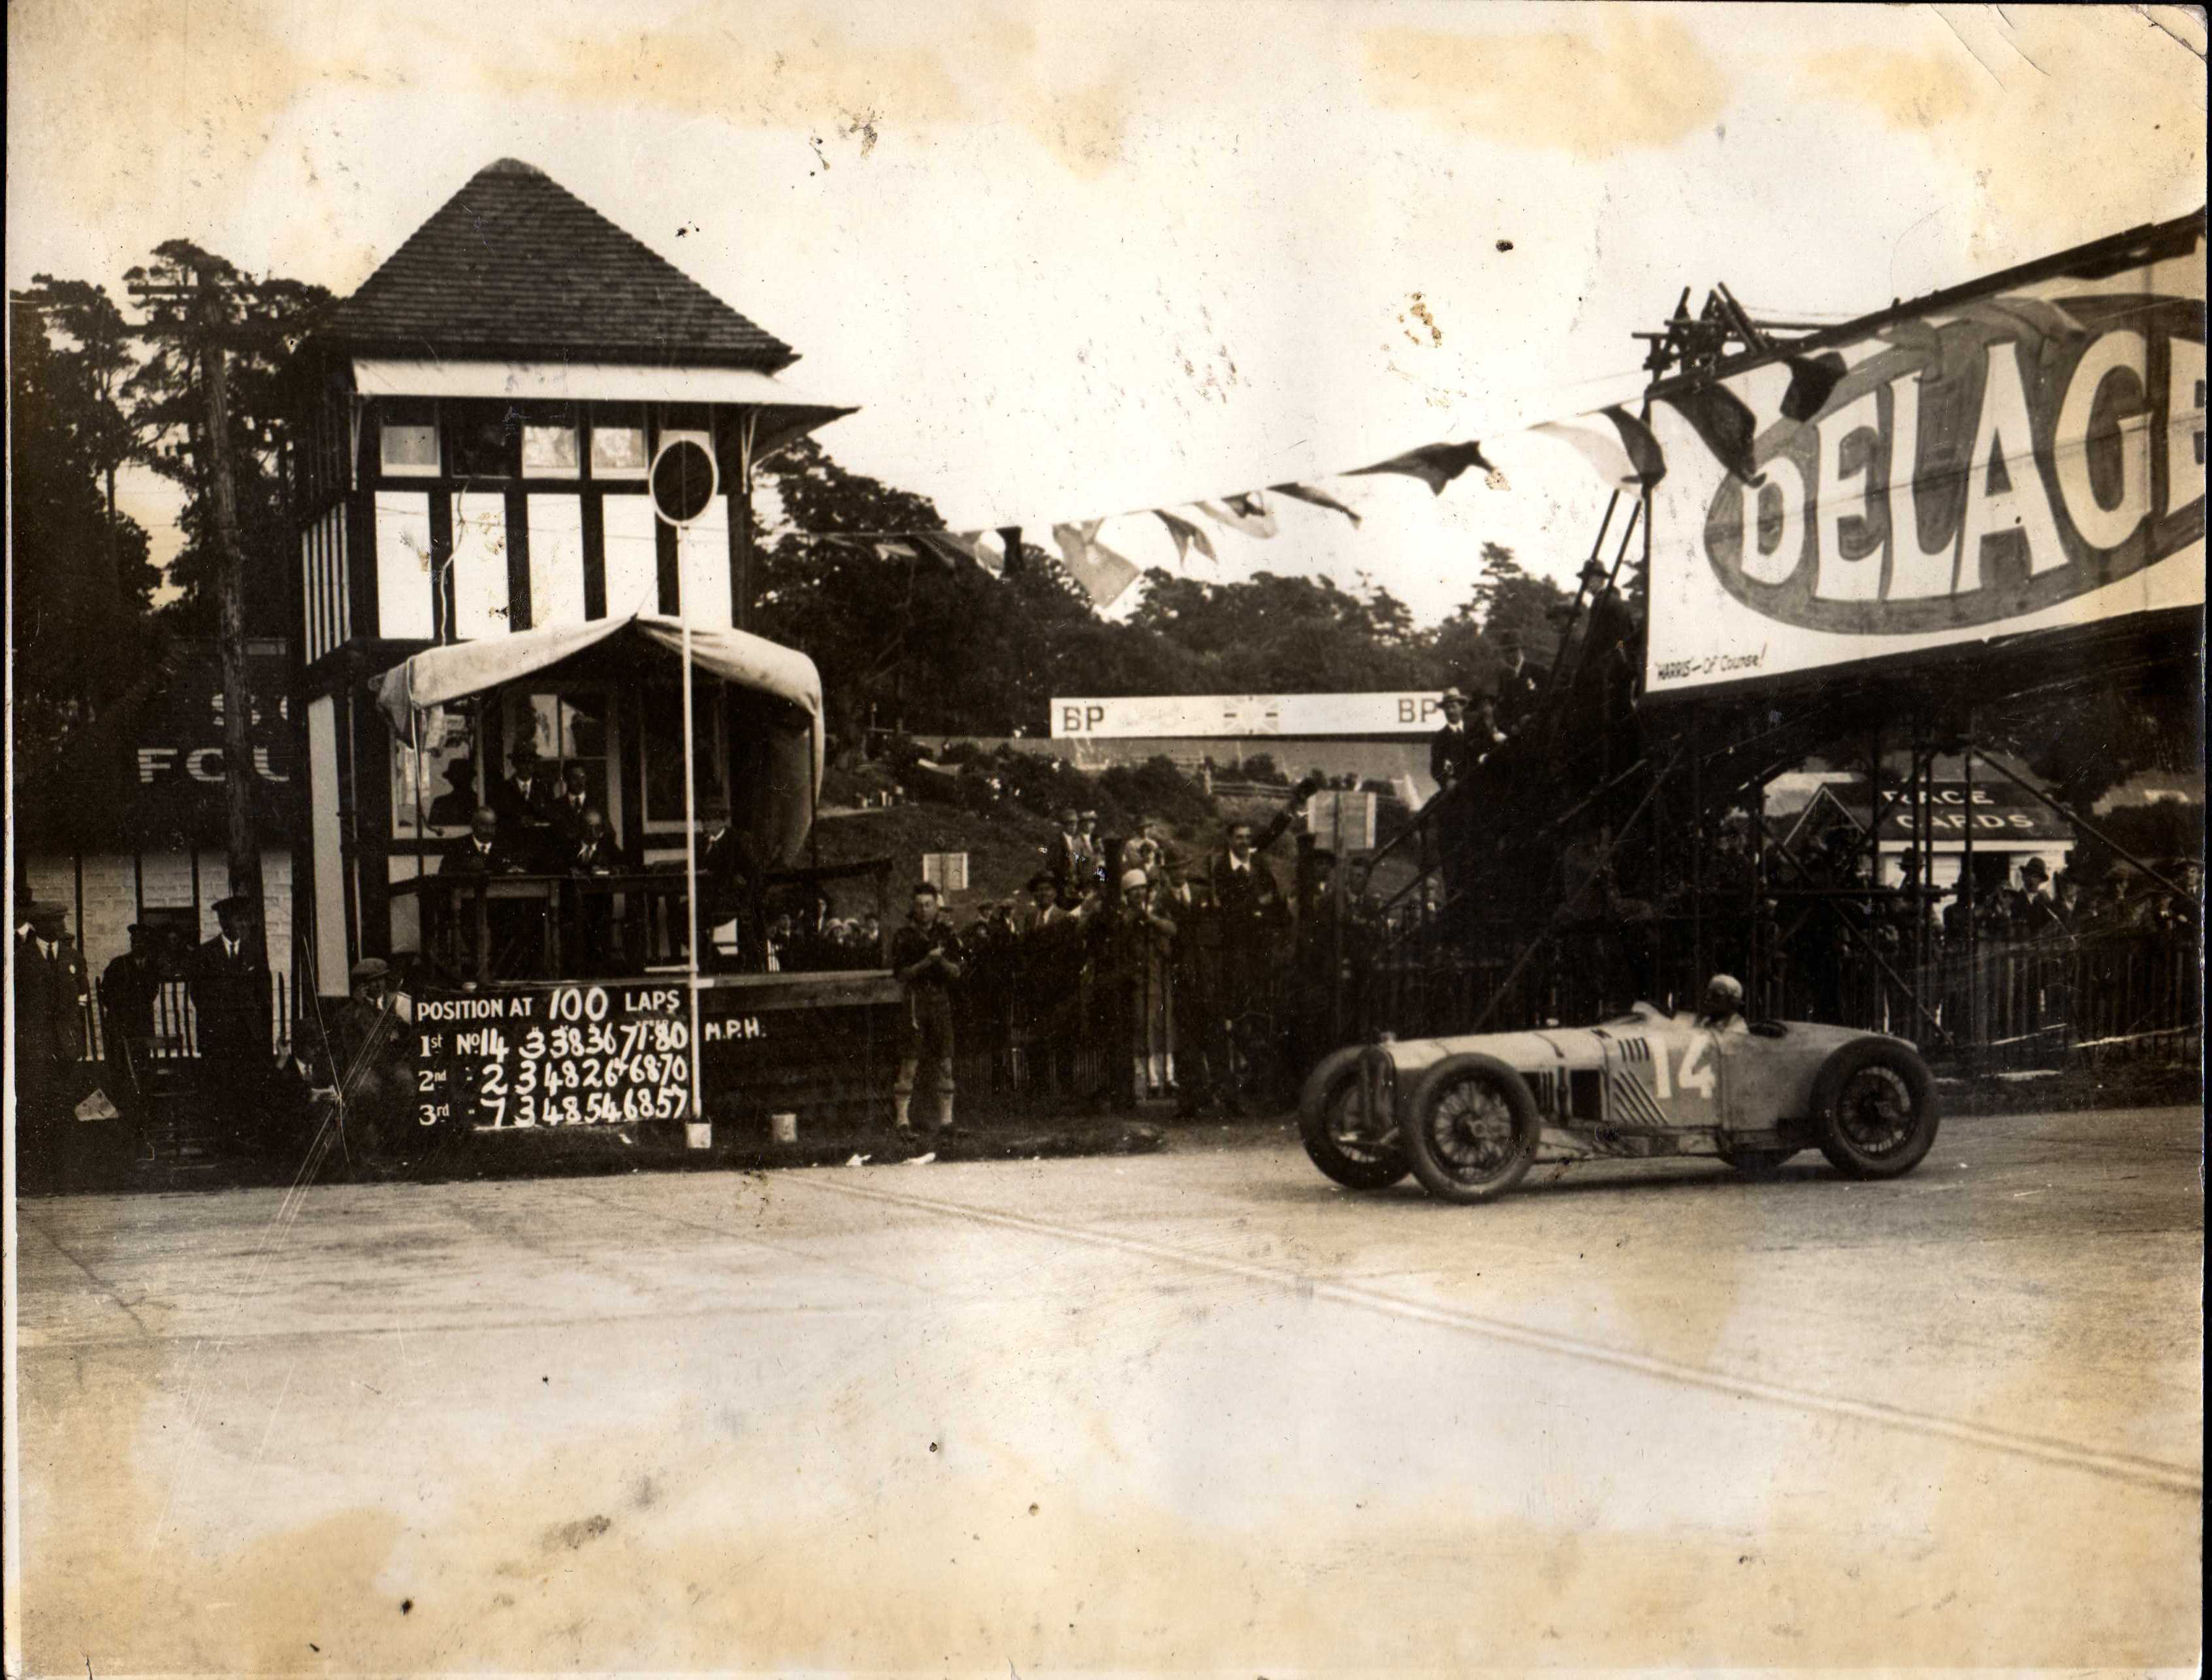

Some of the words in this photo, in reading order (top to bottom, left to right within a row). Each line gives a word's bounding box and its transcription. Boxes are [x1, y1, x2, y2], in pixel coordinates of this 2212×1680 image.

[1063, 706, 1104, 731] BP
[1398, 698, 1437, 723] BP
[417, 998, 504, 1022] POSITION
[509, 997, 533, 1016] AT
[549, 986, 609, 1021] 100
[625, 990, 680, 1013] LAPS
[420, 1034, 443, 1057] 1st
[481, 1028, 510, 1063] 14
[519, 1031, 546, 1059] 3
[550, 1027, 585, 1058] 38
[586, 1023, 617, 1054] 36
[419, 1069, 447, 1091] 2nd
[481, 1063, 508, 1095] 2
[515, 1060, 537, 1095] 3
[544, 1060, 580, 1096] 48
[1650, 1033, 1717, 1099] 14
[419, 1104, 449, 1125] 3rd
[480, 1097, 505, 1129] 7
[514, 1095, 536, 1127] 3
[543, 1096, 581, 1126] 48
[585, 1092, 622, 1123] 54
